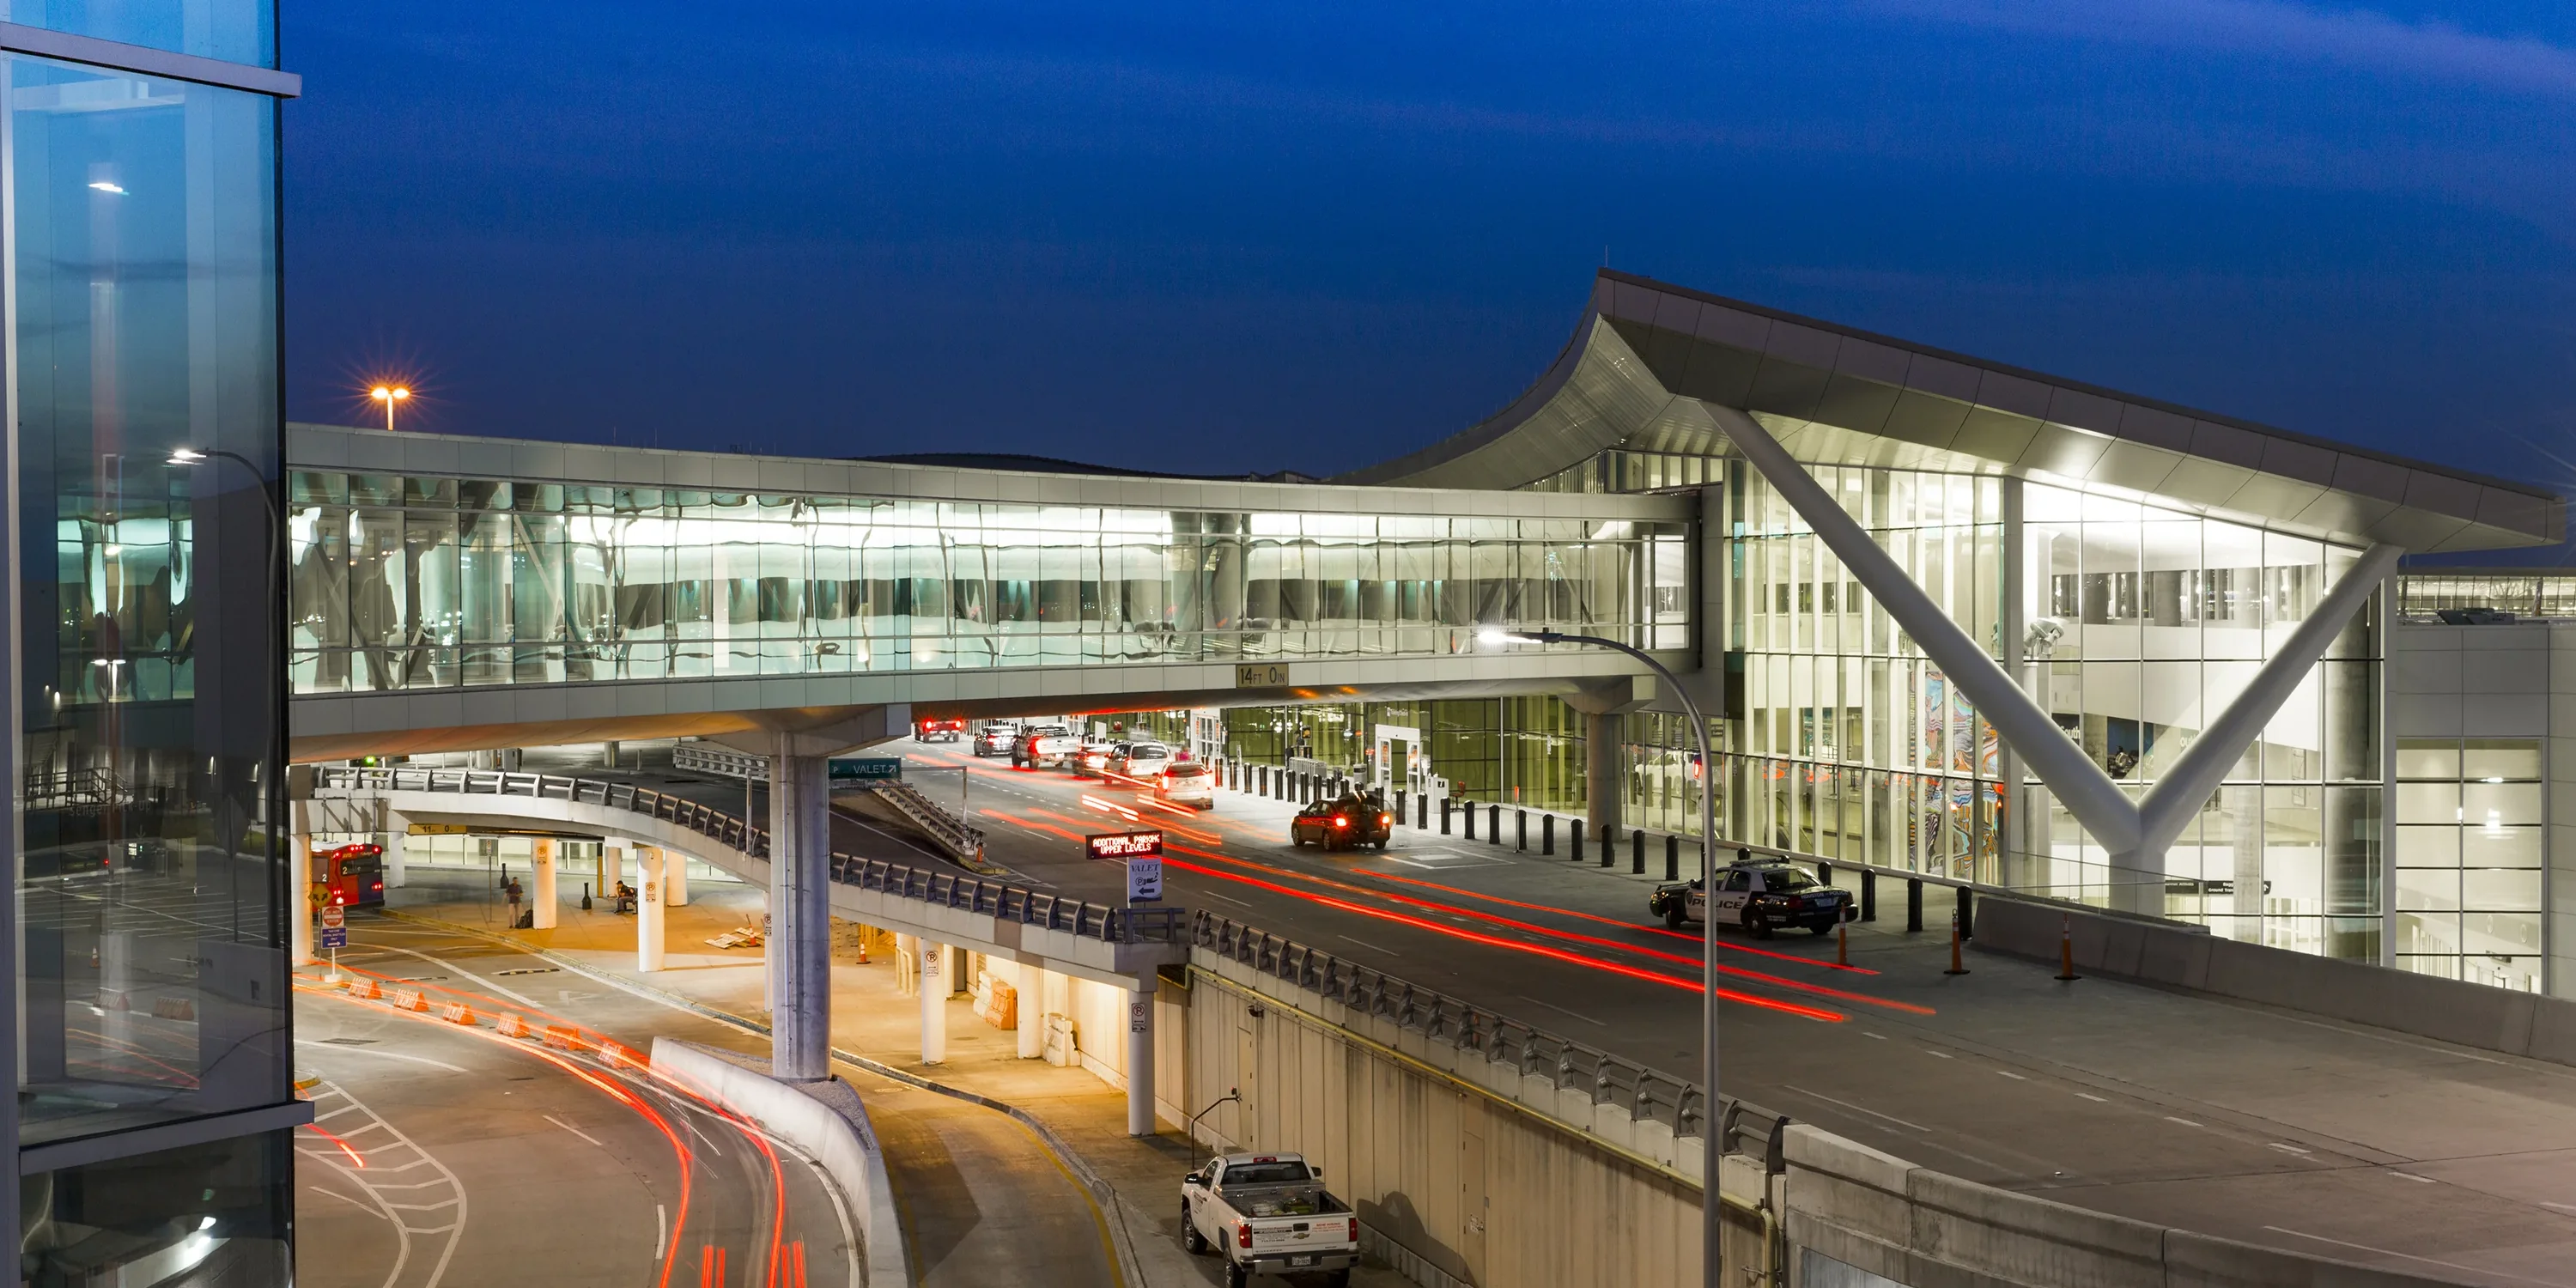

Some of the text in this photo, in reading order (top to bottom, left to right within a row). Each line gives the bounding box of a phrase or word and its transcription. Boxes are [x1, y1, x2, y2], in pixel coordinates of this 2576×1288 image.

[853, 764, 886, 773] VALET
[1093, 835, 1159, 848] ADDITIONAL PARKING
[1100, 843, 1151, 854] UPPER LEVELS
[1131, 864, 1160, 872] VALET
[322, 873, 327, 882] 2
